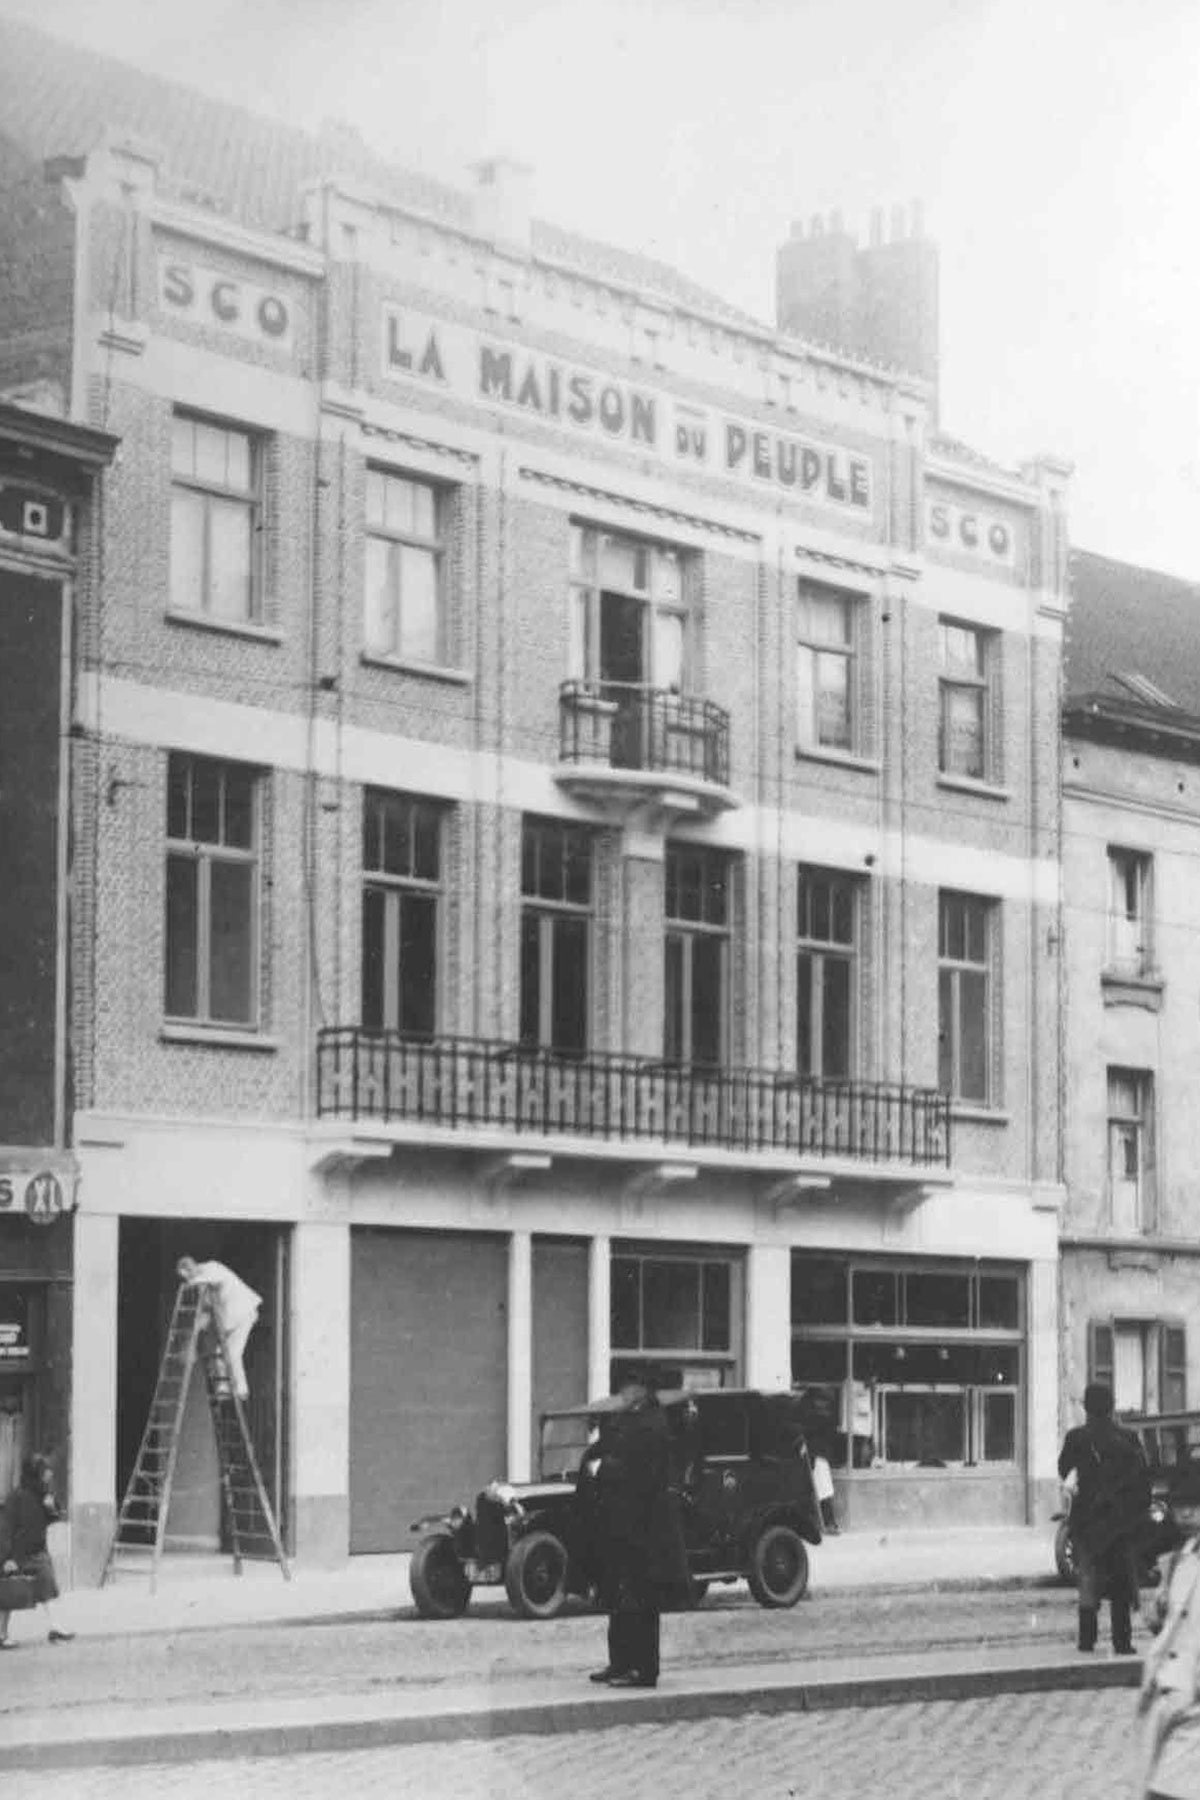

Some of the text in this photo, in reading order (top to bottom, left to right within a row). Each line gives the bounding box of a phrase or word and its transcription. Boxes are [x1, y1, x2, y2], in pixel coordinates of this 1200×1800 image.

[388, 317, 868, 506] LA MAISON DU PEUPLE
